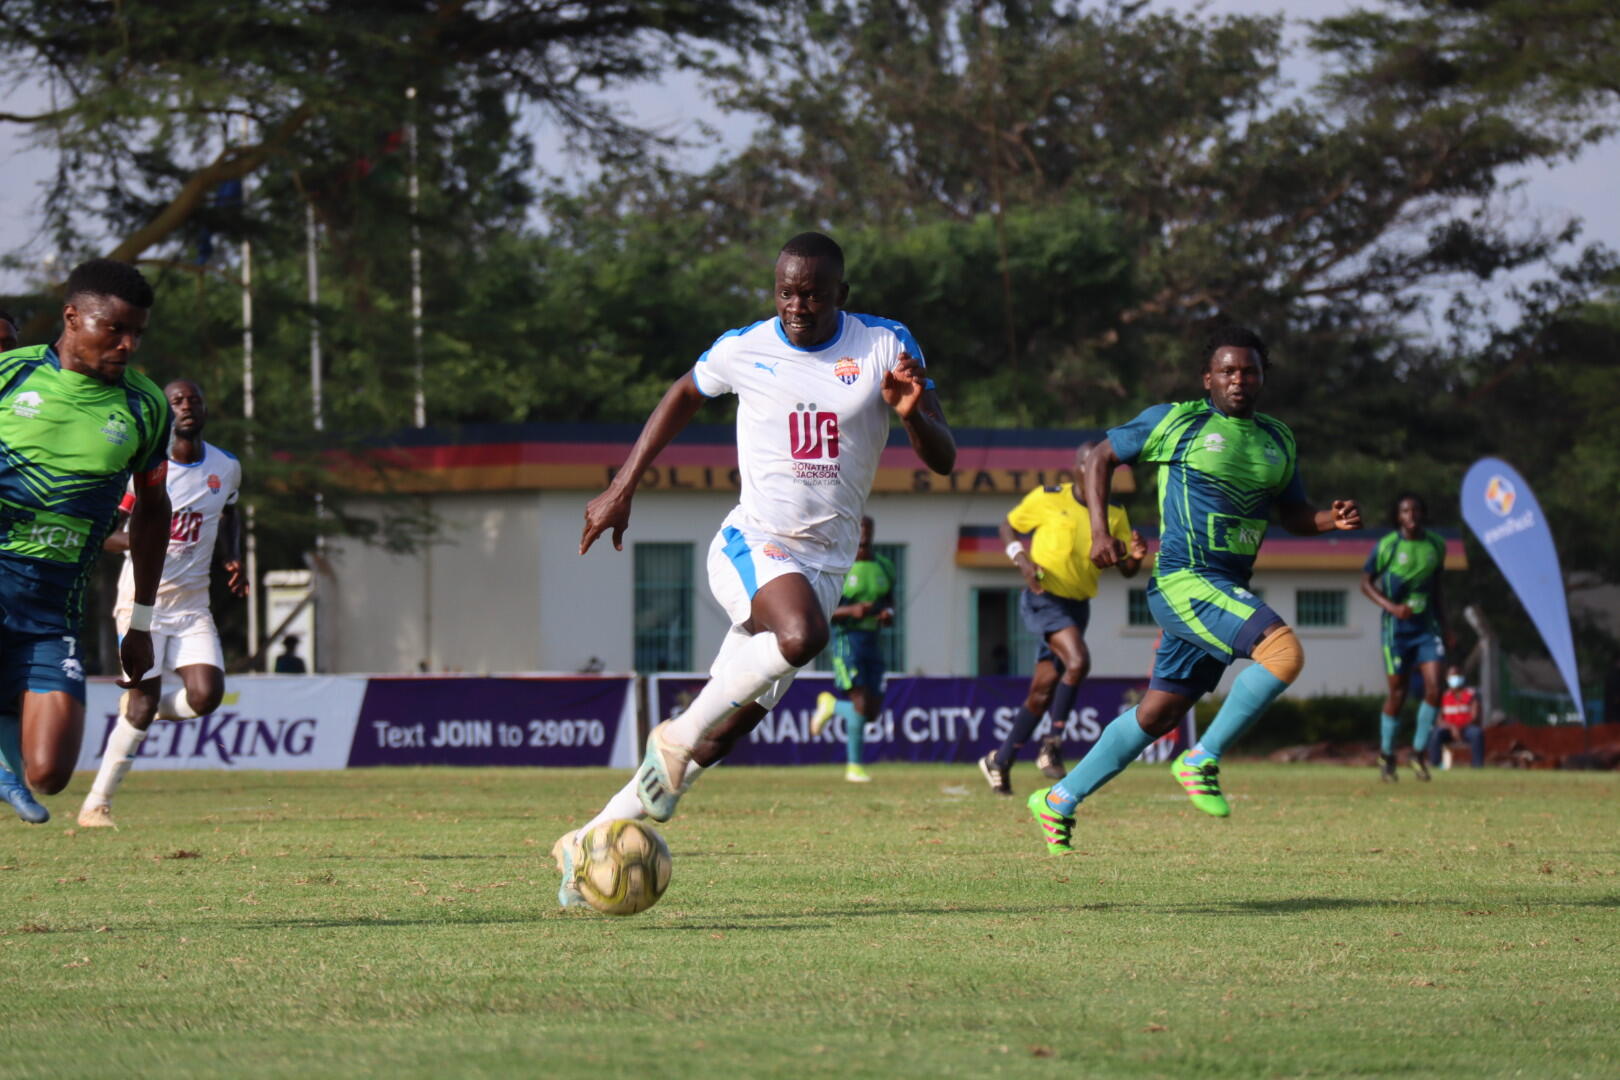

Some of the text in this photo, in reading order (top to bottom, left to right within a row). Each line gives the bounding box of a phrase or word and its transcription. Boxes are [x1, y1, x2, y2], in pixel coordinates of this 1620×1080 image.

[791, 462, 841, 472] JONATHAN
[795, 471, 838, 479] JACKSON
[62, 635, 76, 657] 7
[373, 719, 605, 748] Text JOIN to 29070
[902, 707, 986, 743] CITY
[993, 706, 1102, 742] SARS
